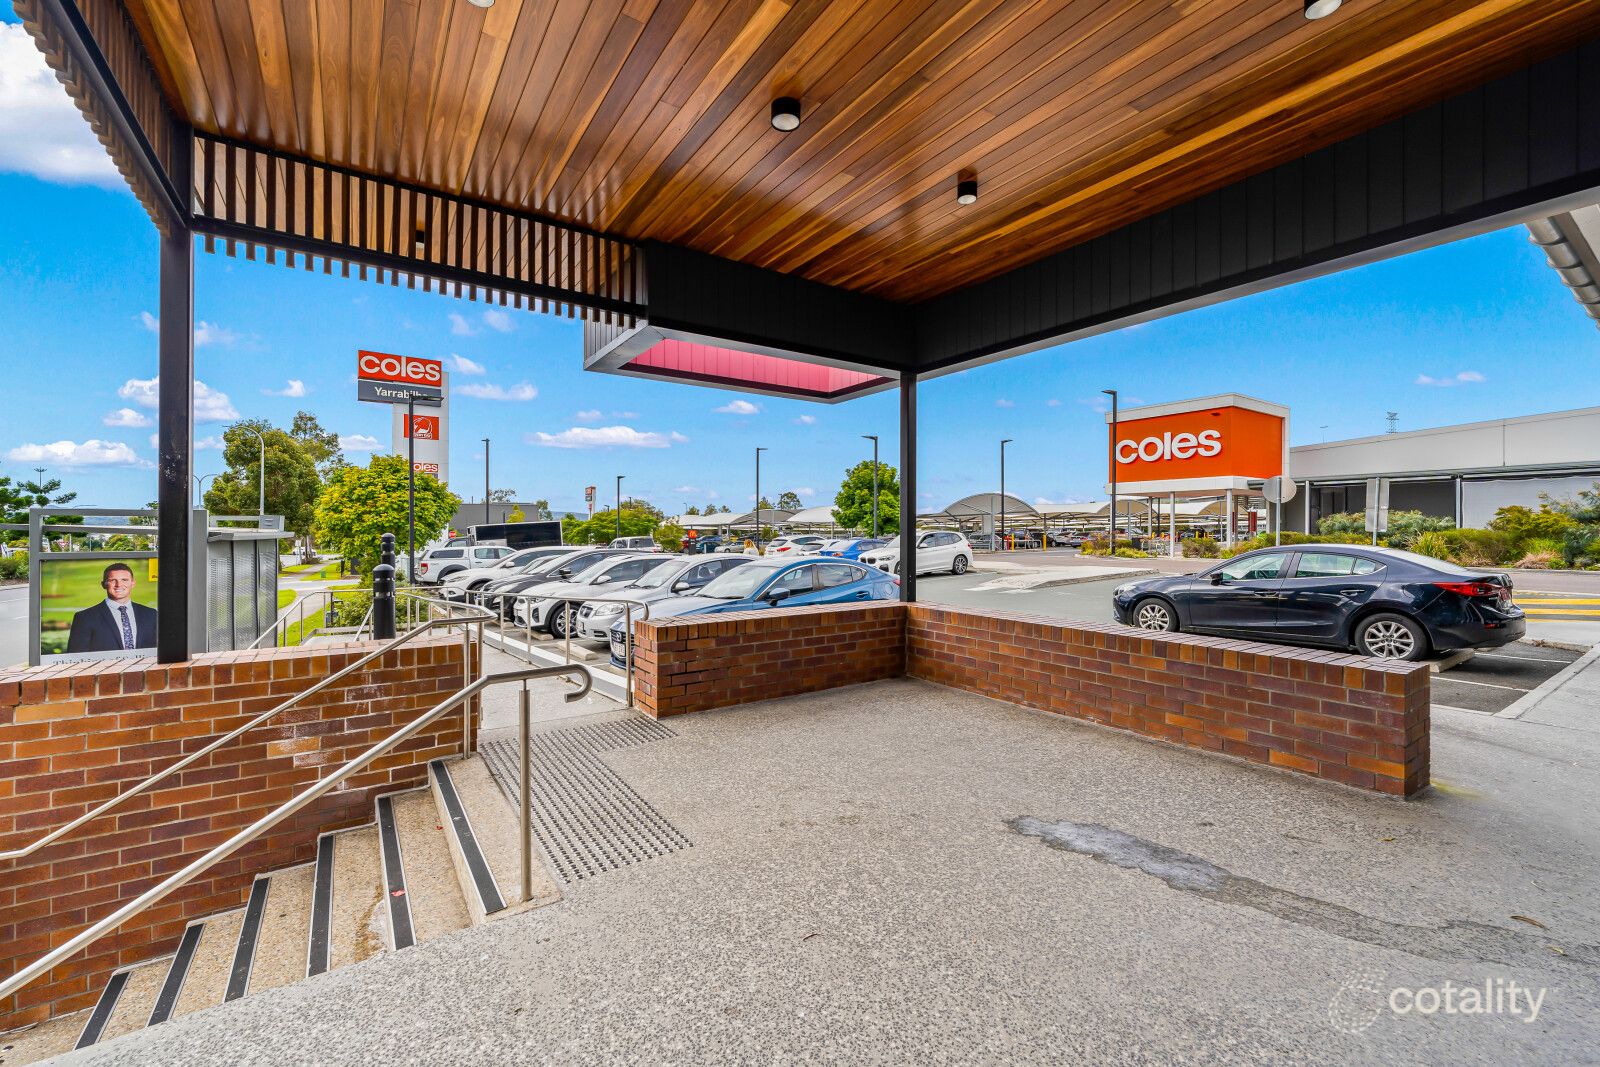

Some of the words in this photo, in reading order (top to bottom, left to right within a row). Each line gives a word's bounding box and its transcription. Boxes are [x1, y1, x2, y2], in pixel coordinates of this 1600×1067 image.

[360, 355, 441, 381] coles
[1116, 429, 1222, 464] coles
[413, 462, 438, 472] oles
